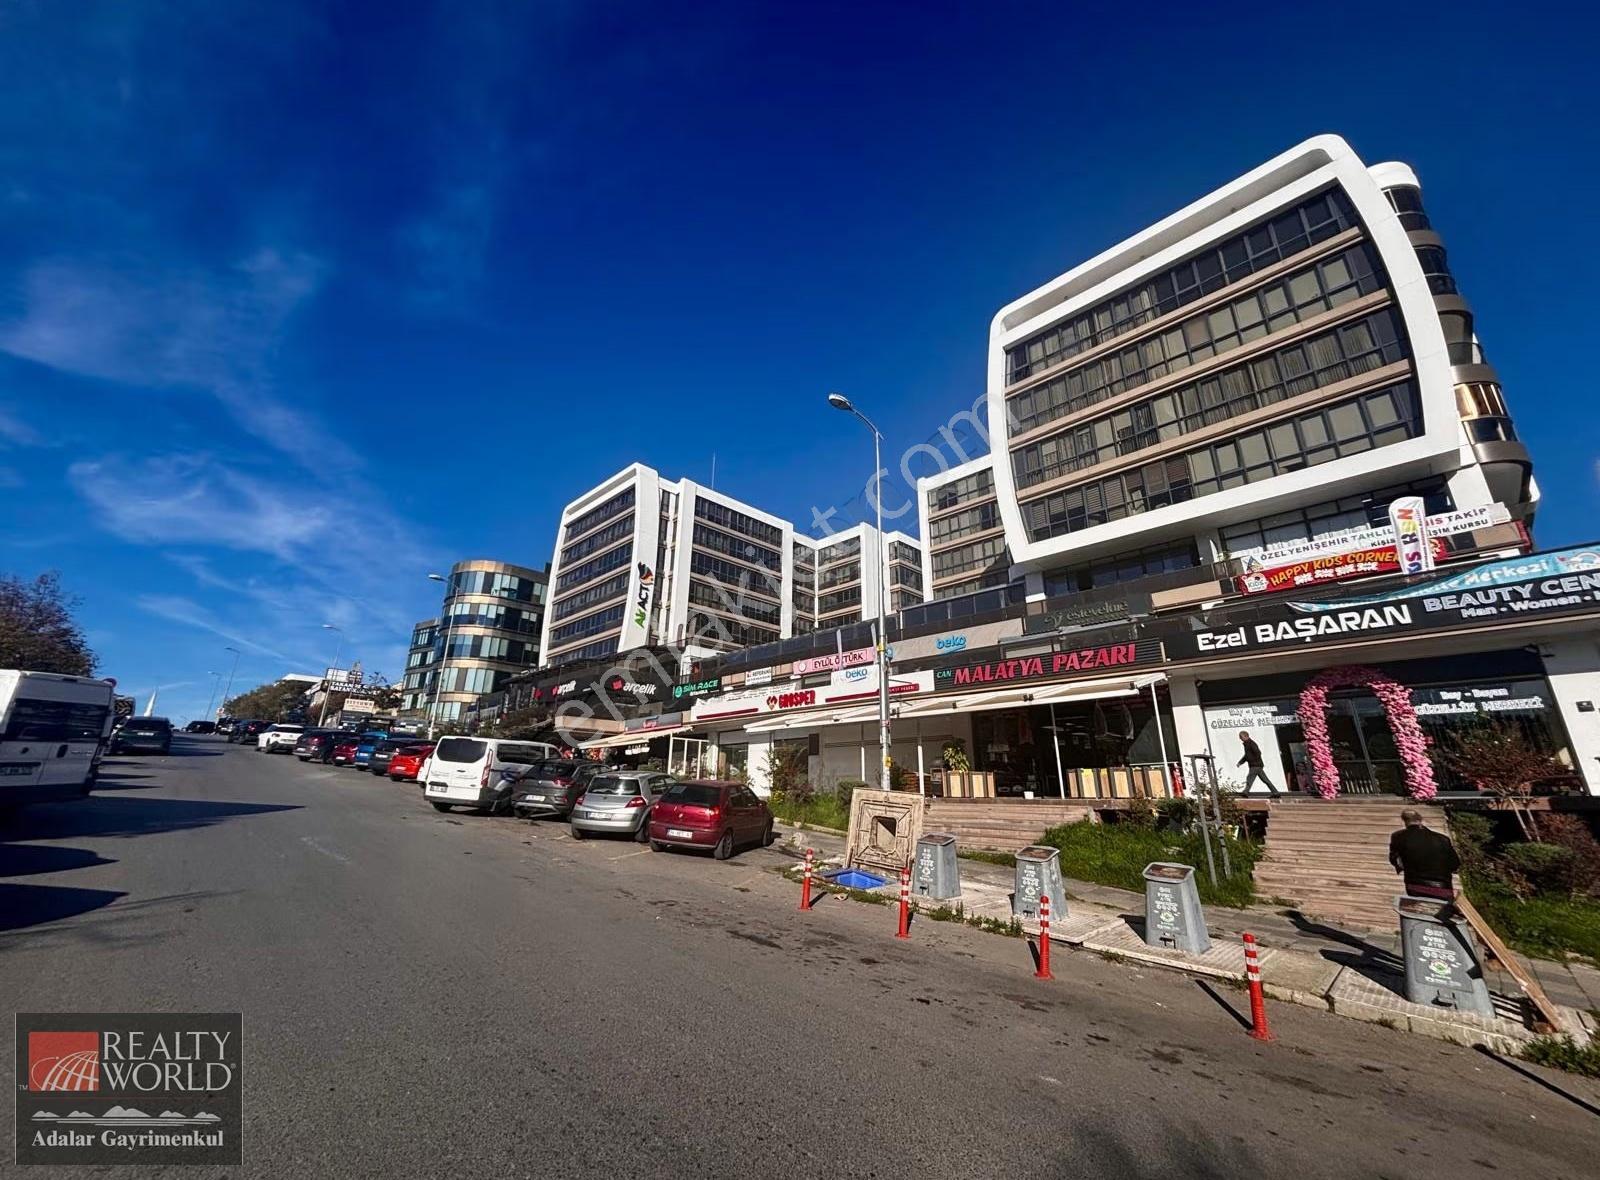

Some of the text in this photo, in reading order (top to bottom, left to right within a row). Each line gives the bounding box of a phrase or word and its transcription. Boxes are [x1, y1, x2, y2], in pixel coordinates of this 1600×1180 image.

[1260, 551, 1287, 561] ÖZEL
[1288, 537, 1349, 556] YENİŞEHİR
[1447, 507, 1487, 521] TAKİP
[1452, 519, 1489, 531] KURSU
[1270, 563, 1310, 587] HAPPY
[1422, 583, 1534, 613] BEAUTY
[1460, 606, 1498, 619] Man
[1510, 594, 1582, 612] Women
[1197, 604, 1412, 651] Ezel BAŞARAN
[936, 632, 967, 651] beko
[845, 668, 868, 680] beko
[936, 669, 952, 680] CAN
[953, 641, 1137, 685] MALATYA PAZARI
[623, 681, 657, 695] arçelik
